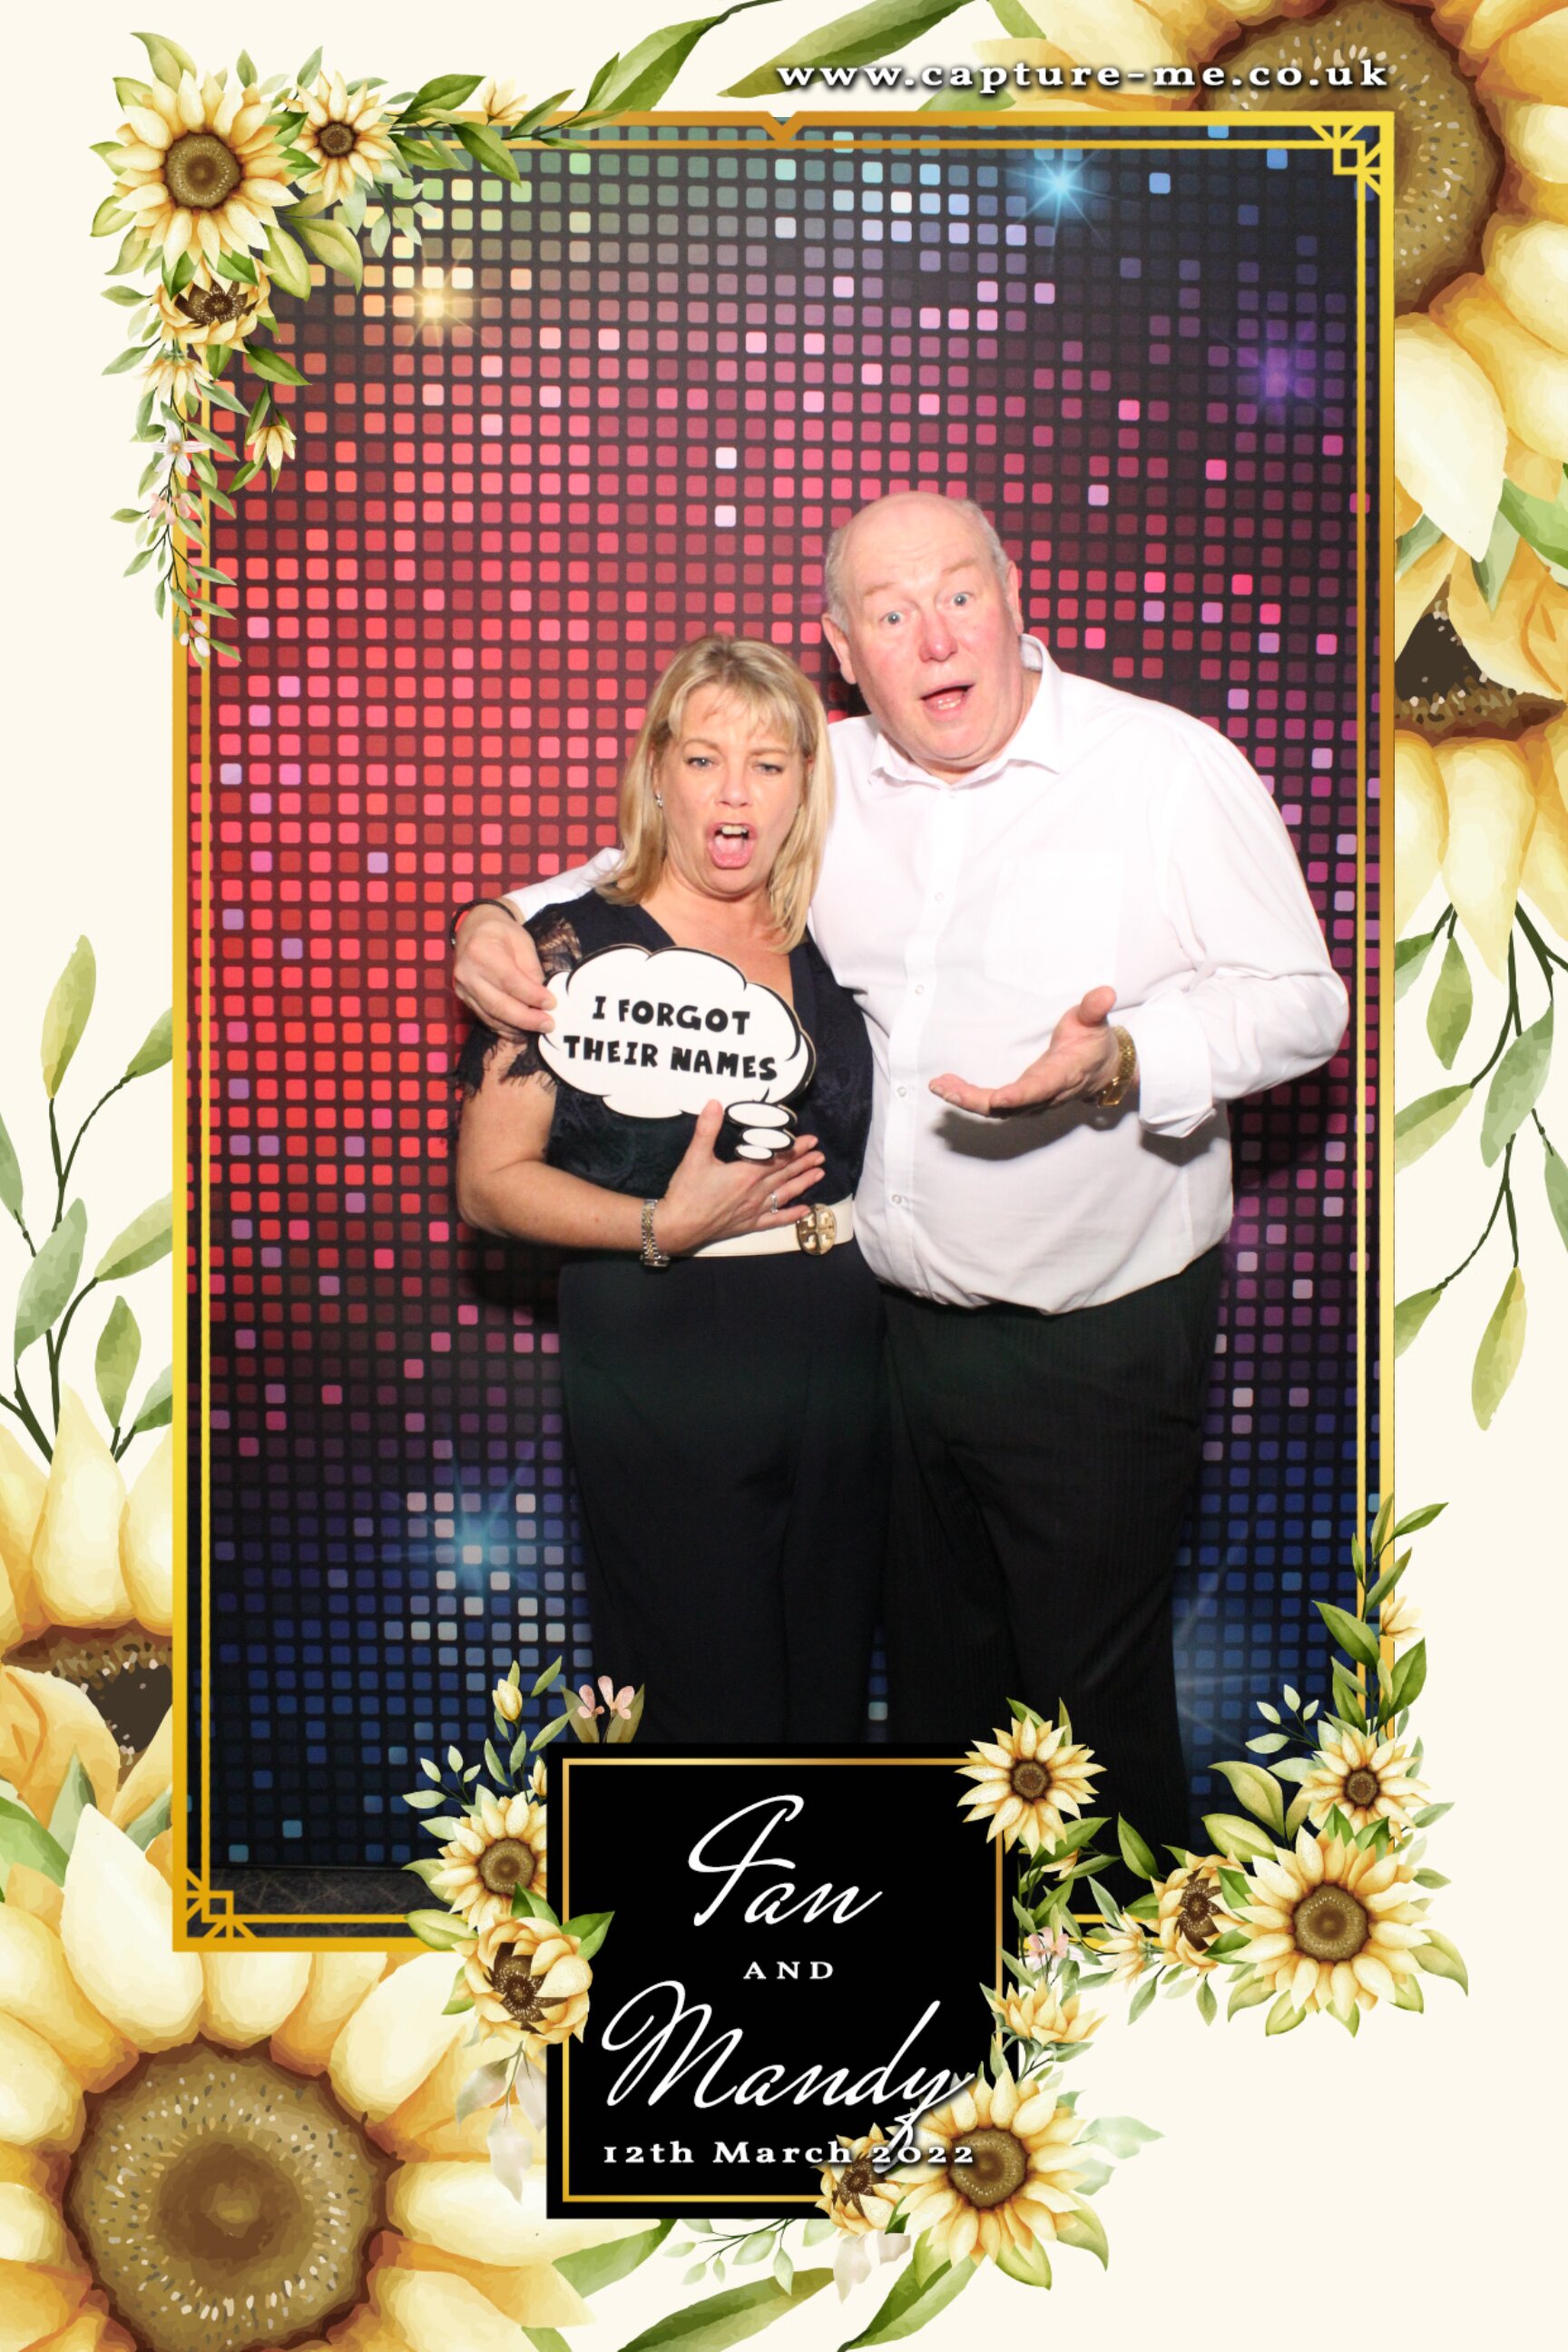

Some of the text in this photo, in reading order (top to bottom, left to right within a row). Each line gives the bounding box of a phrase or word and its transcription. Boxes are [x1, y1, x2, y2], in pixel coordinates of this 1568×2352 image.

[592, 995, 750, 1035] I FORGOT
[563, 1034, 778, 1082] THEIR NAMES
